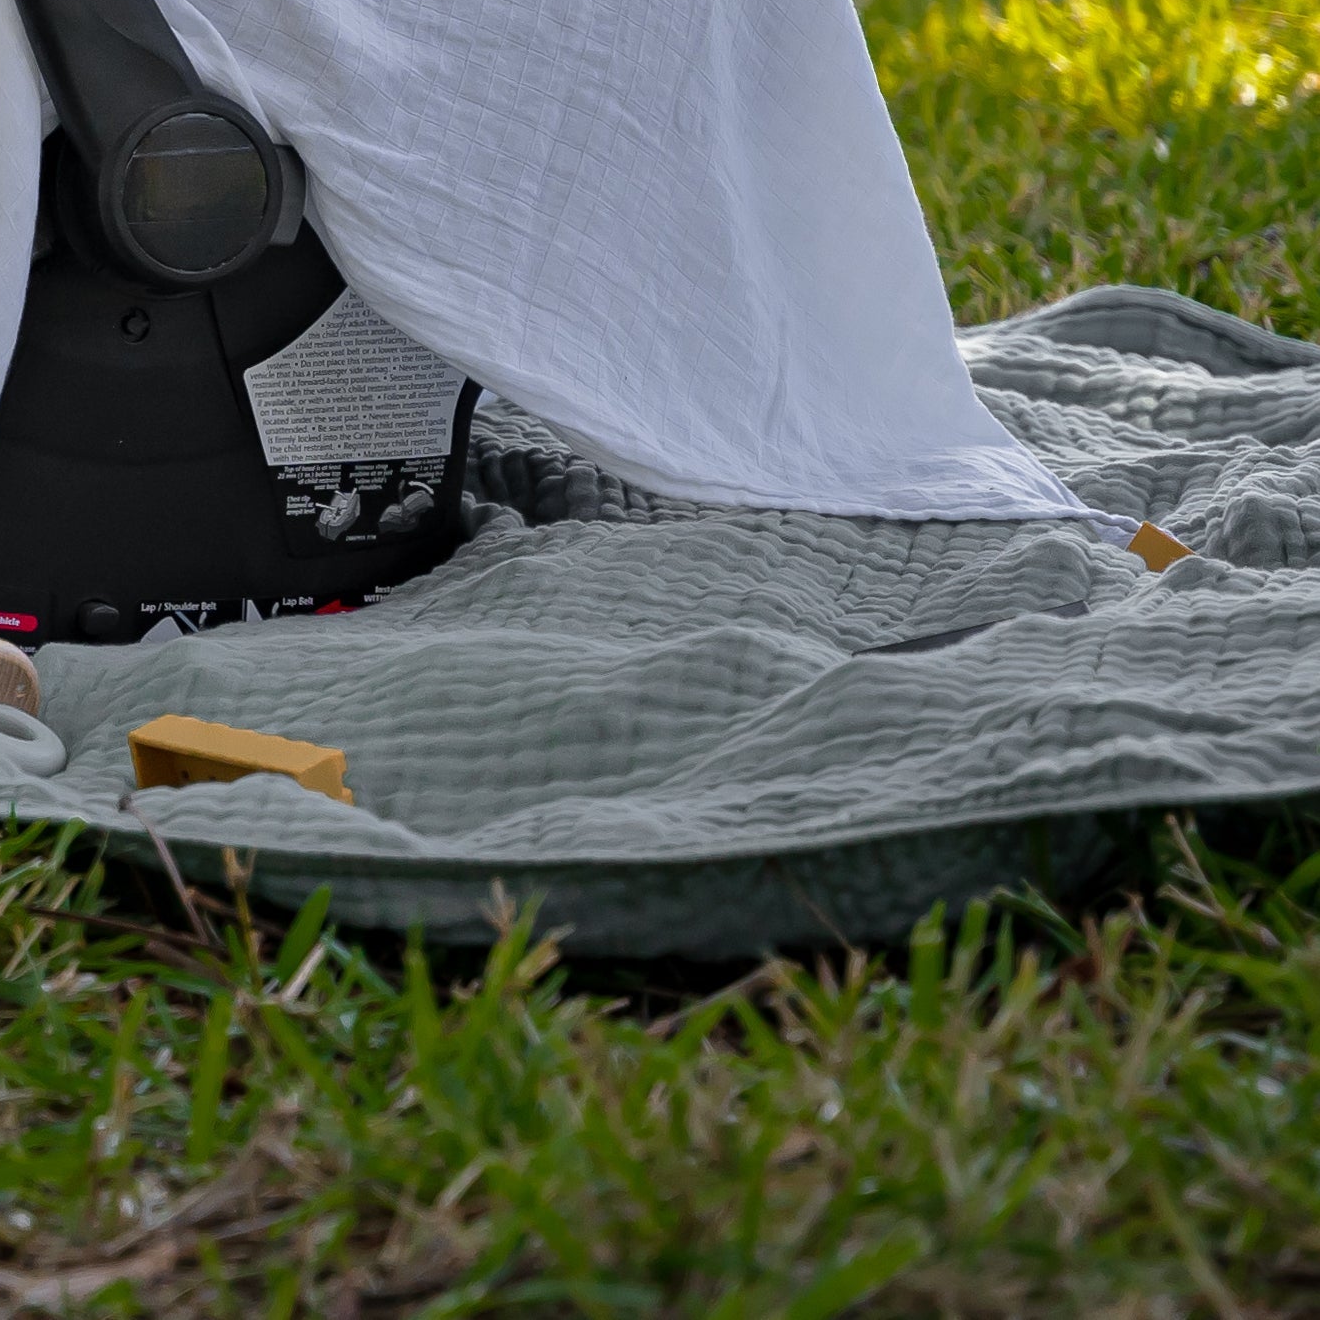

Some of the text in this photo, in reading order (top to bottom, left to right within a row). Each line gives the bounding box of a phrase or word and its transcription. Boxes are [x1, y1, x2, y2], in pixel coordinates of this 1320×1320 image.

[368, 319, 379, 327] the
[341, 329, 369, 337] restraint
[371, 328, 396, 336] around
[296, 341, 312, 349] child
[315, 340, 342, 348] restraint
[356, 337, 407, 348] forward-facing
[305, 350, 330, 358] vehicle
[332, 349, 345, 357] seat
[347, 348, 360, 356] belt
[379, 346, 398, 354] lower
[301, 360, 312, 368] Do
[313, 359, 325, 367] not
[327, 358, 345, 369] place
[362, 356, 391, 364] restraint
[313, 369, 347, 378] passenger
[399, 364, 420, 372] Never
[298, 377, 349, 388] forward-facing
[350, 375, 381, 386] position.
[428, 372, 445, 380] child
[348, 385, 366, 393] child
[368, 384, 397, 392] restraint
[399, 382, 435, 392] anchorage
[308, 397, 324, 405] with
[333, 395, 357, 403] vehicle
[360, 394, 375, 402] belt.
[419, 390, 455, 398] instructions
[272, 408, 285, 416] this
[286, 407, 304, 415] child
[306, 406, 335, 414] restraint
[353, 404, 359, 412] in
[376, 402, 401, 410] written
[292, 416, 313, 424] under
[315, 415, 327, 423] the
[345, 414, 359, 424] pad.
[369, 412, 391, 420] Never
[393, 411, 410, 419] leave
[412, 410, 429, 418] child
[265, 426, 309, 434] unattended.
[345, 423, 360, 431] that
[362, 422, 374, 430] the
[377, 421, 394, 429] child
[395, 420, 424, 428] restraint
[324, 433, 338, 441] into
[354, 432, 374, 442] Carry
[404, 429, 427, 437] before
[284, 445, 302, 453] child
[344, 442, 372, 452] Register
[373, 441, 390, 451] your
[392, 439, 409, 447] child
[411, 438, 438, 446] restraint
[273, 454, 290, 462] with
[306, 452, 355, 460] manufacturer.
[363, 449, 413, 457] Manufactured
[424, 446, 444, 454] China.
[141, 601, 217, 613] Lap / Shoulder Belt
[282, 596, 313, 607] Lap Belt
